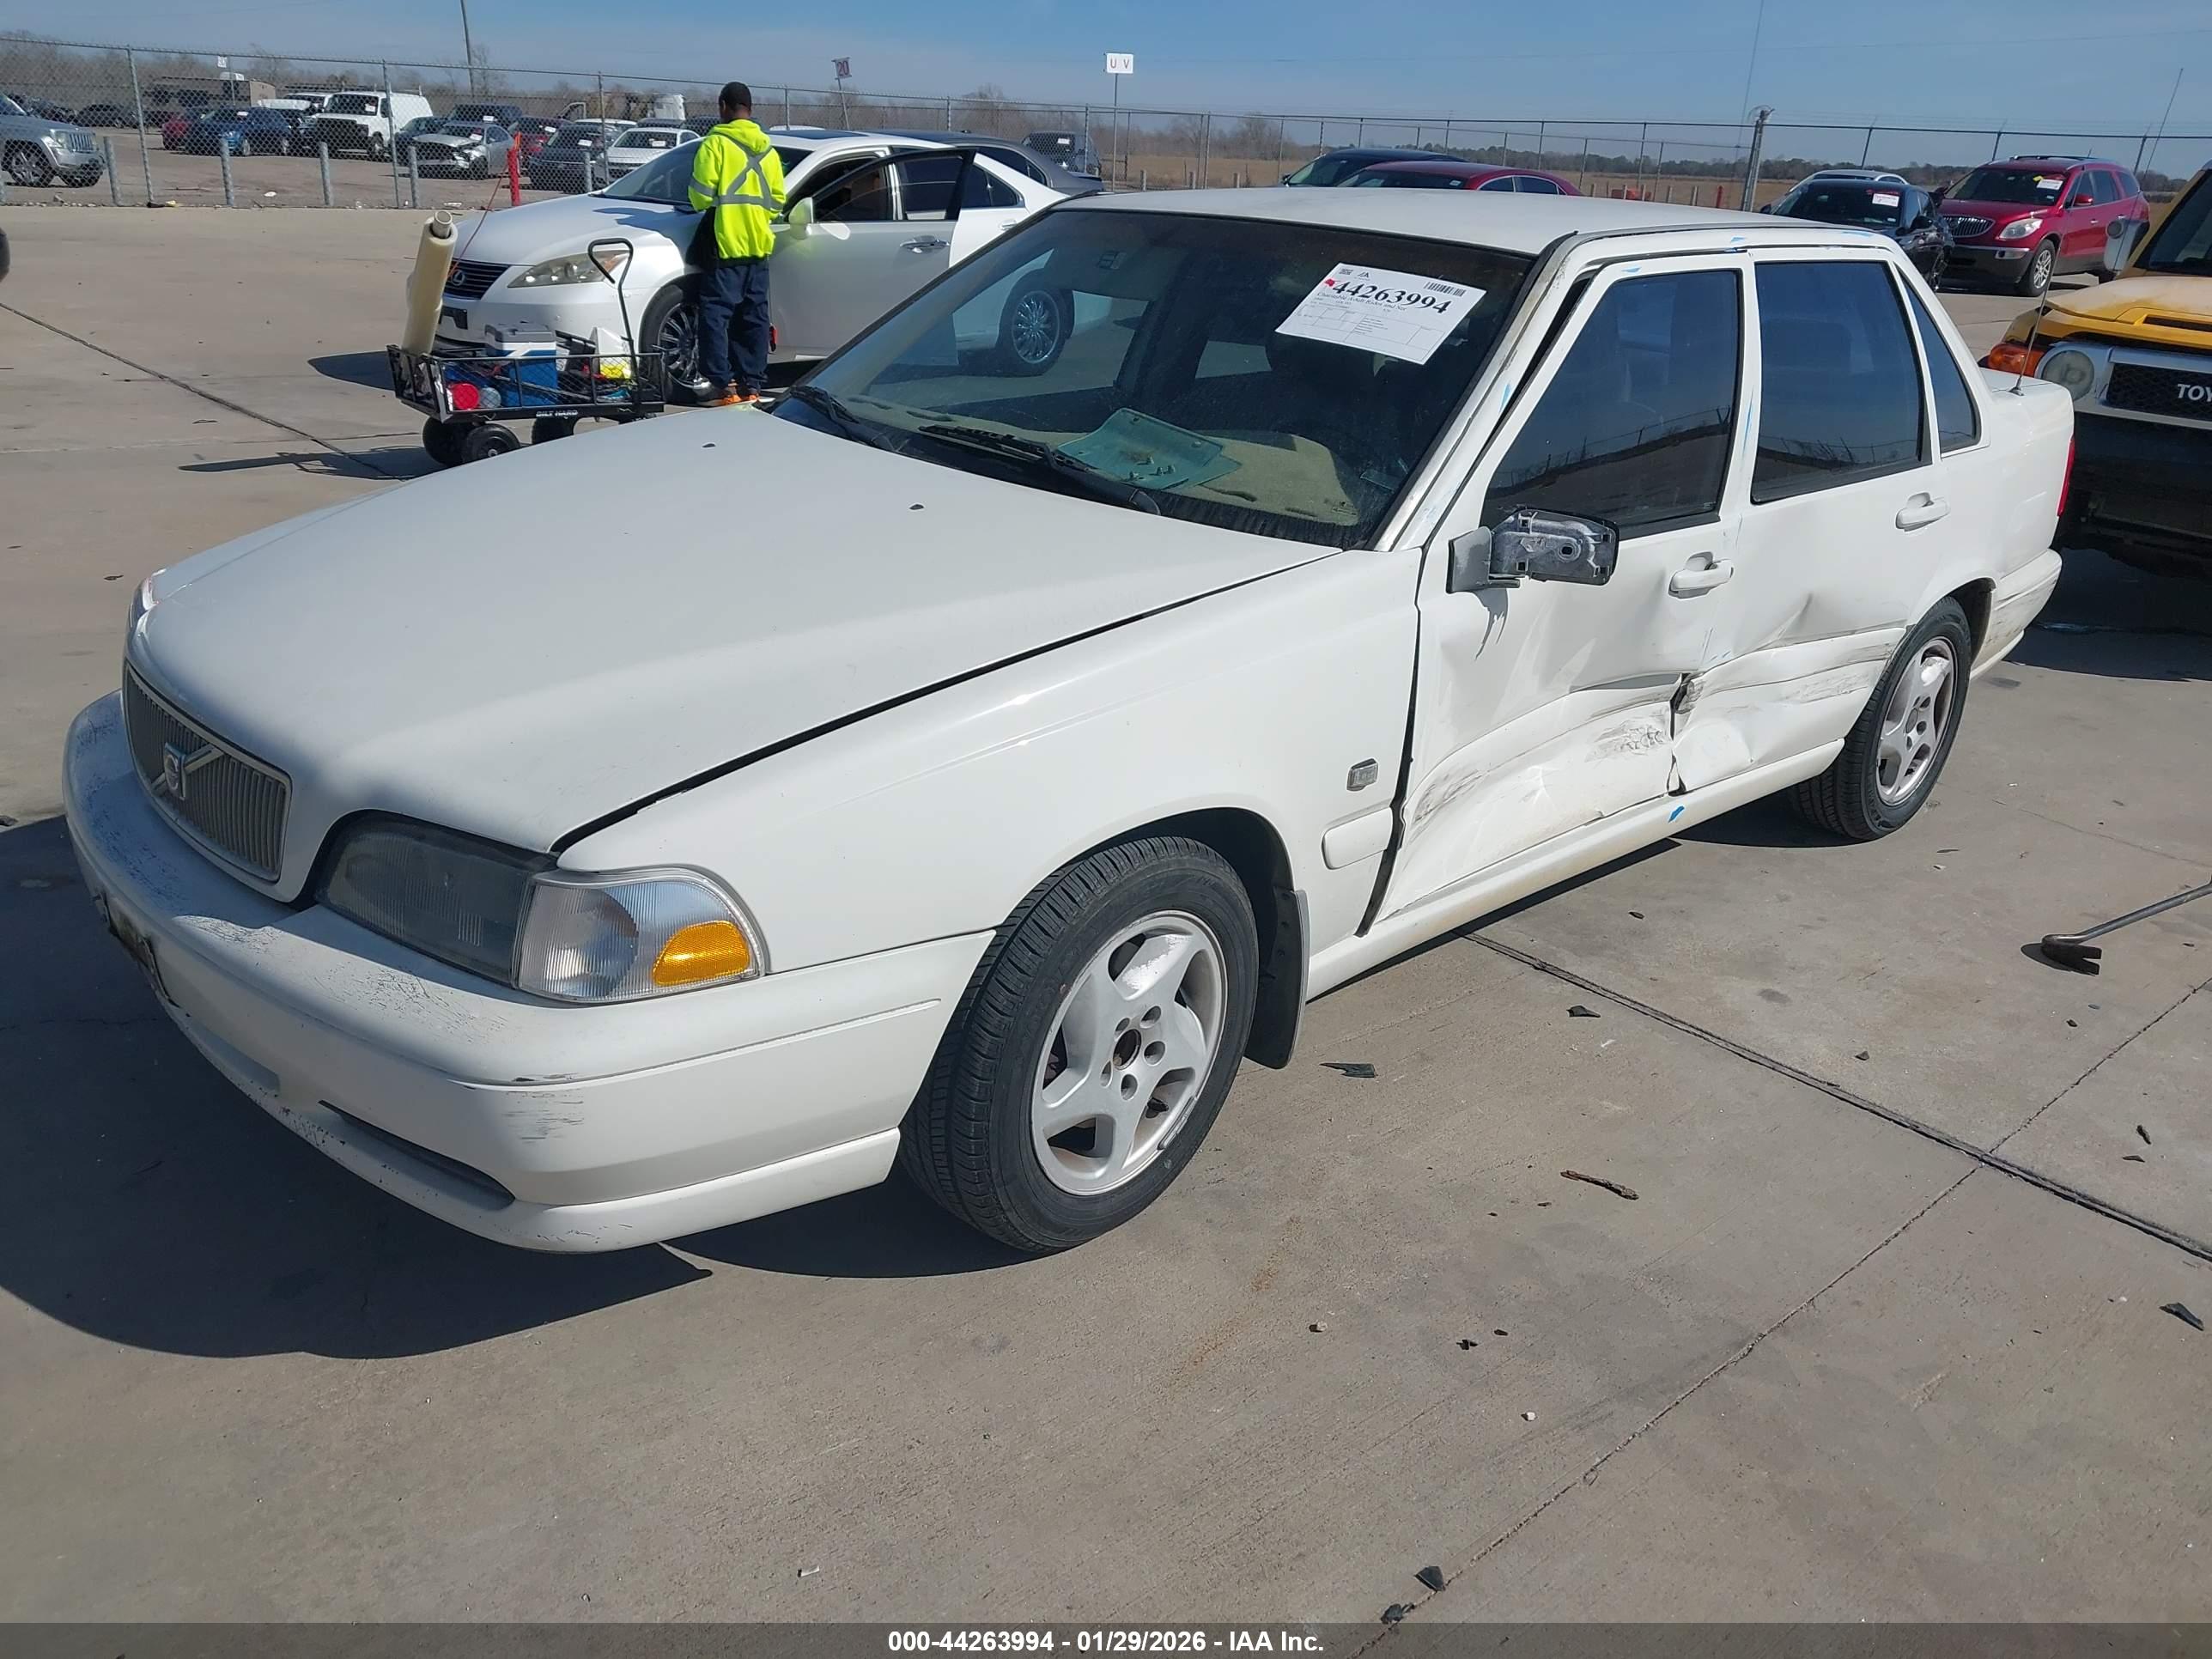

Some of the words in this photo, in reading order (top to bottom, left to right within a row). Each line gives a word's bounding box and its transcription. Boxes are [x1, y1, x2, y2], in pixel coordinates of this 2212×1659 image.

[837, 60, 850, 76] 20
[1110, 58, 1117, 69] U
[1123, 58, 1130, 70] V
[1333, 281, 1452, 314] 44263994
